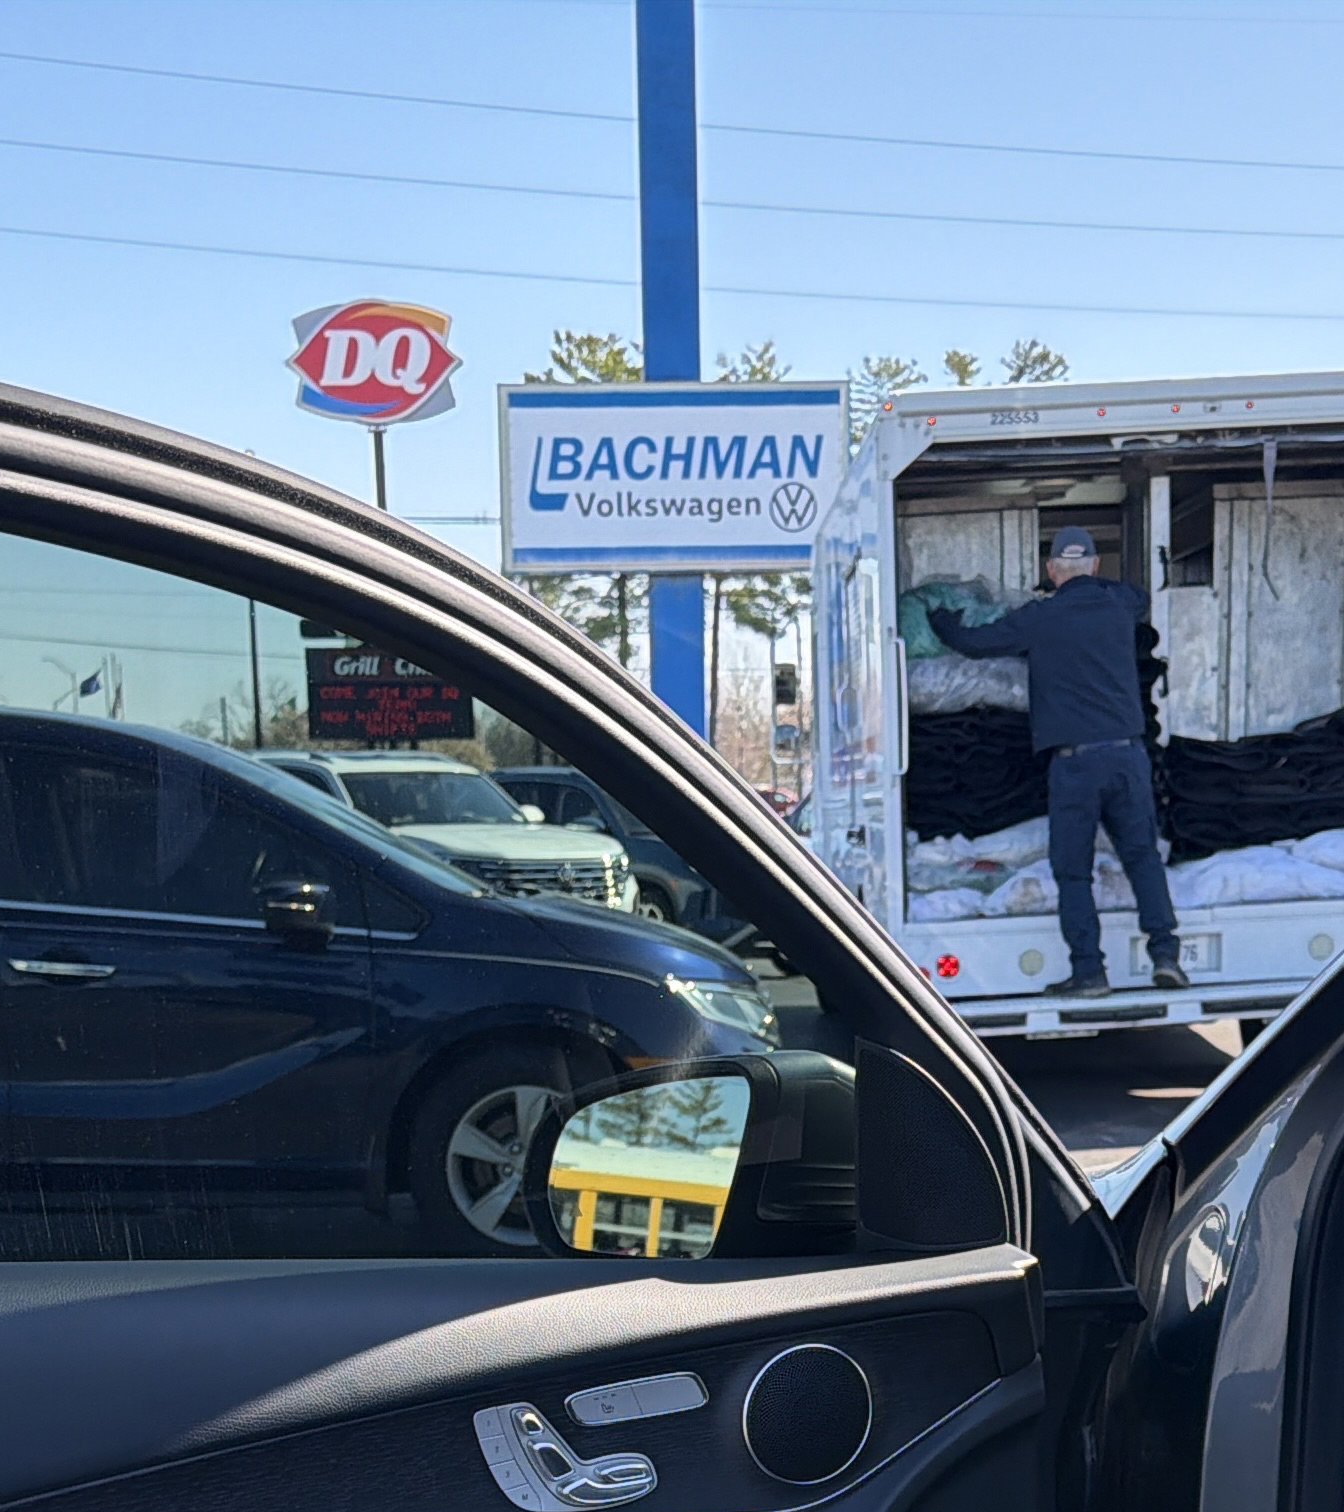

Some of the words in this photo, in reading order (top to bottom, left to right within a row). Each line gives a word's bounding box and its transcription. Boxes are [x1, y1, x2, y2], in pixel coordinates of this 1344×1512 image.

[319, 327, 432, 394] DQ
[547, 434, 824, 481] BACHMAN
[574, 491, 761, 523] Volkswagen
[334, 656, 381, 676] Grill
